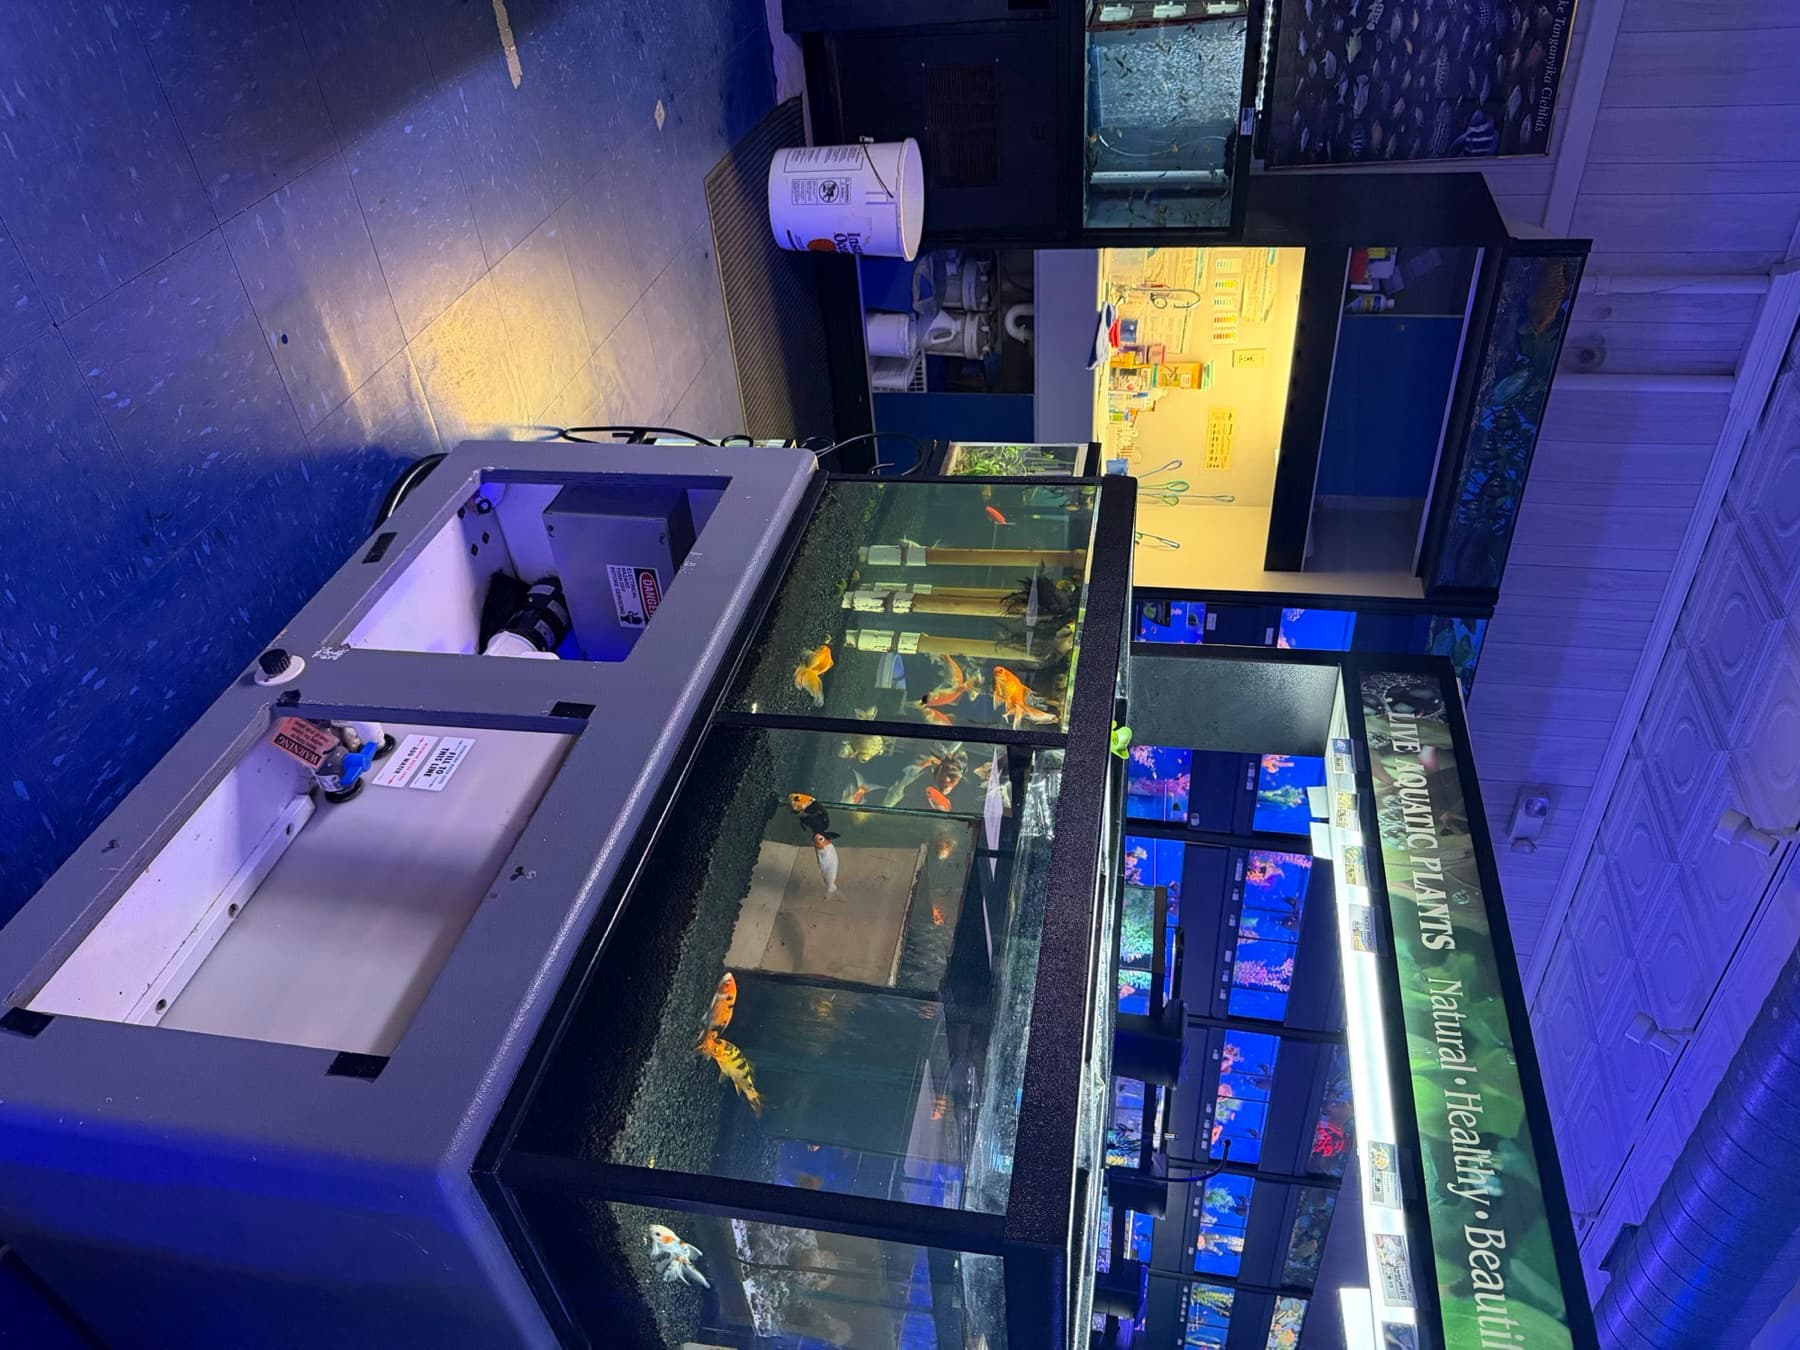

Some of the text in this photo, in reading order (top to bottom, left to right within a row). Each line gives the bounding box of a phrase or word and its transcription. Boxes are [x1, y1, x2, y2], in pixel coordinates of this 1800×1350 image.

[1543, 17, 1567, 83] Tanganyika
[1534, 87, 1553, 132] Cichlids
[626, 568, 638, 599] ELECTRICAL
[275, 736, 318, 764] WARNING
[423, 747, 450, 777] THIS LINE
[442, 751, 457, 764] FILL
[393, 758, 412, 775] WATER
[435, 767, 447, 775] TO
[1387, 711, 1456, 950] LIVE AQUATIC PLANTS
[1427, 977, 1478, 1072] Natural
[1444, 1088, 1496, 1206] Healthy
